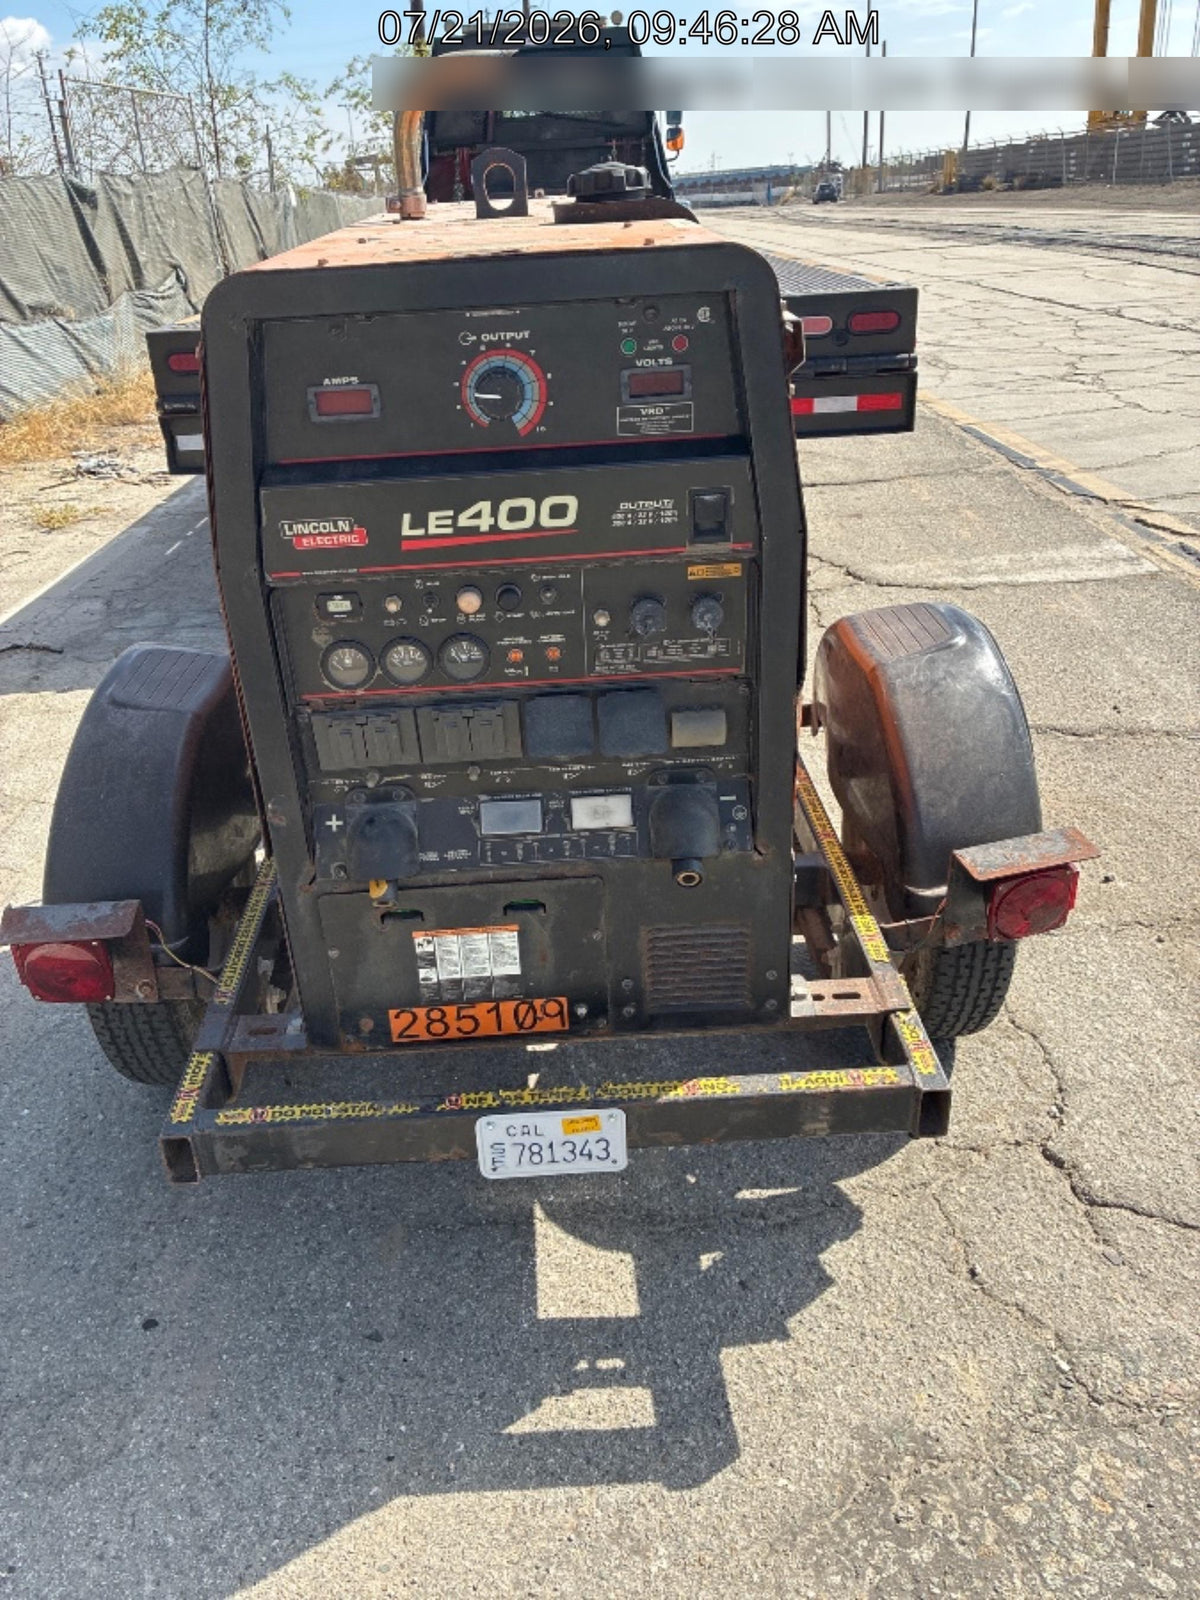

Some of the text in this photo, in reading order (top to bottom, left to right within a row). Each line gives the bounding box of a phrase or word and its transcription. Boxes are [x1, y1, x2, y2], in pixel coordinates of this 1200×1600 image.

[481, 330, 531, 342] OUTPUT
[635, 357, 673, 367] VOLTS
[323, 376, 360, 387] AMPS
[401, 494, 579, 537] LE400
[284, 519, 350, 536] LINCOLN
[302, 533, 360, 547] ELECTRIC
[394, 999, 566, 1039] 285109
[272, 1110, 296, 1119] DO
[505, 1124, 545, 1138] CAL
[511, 1137, 611, 1167] 781343
